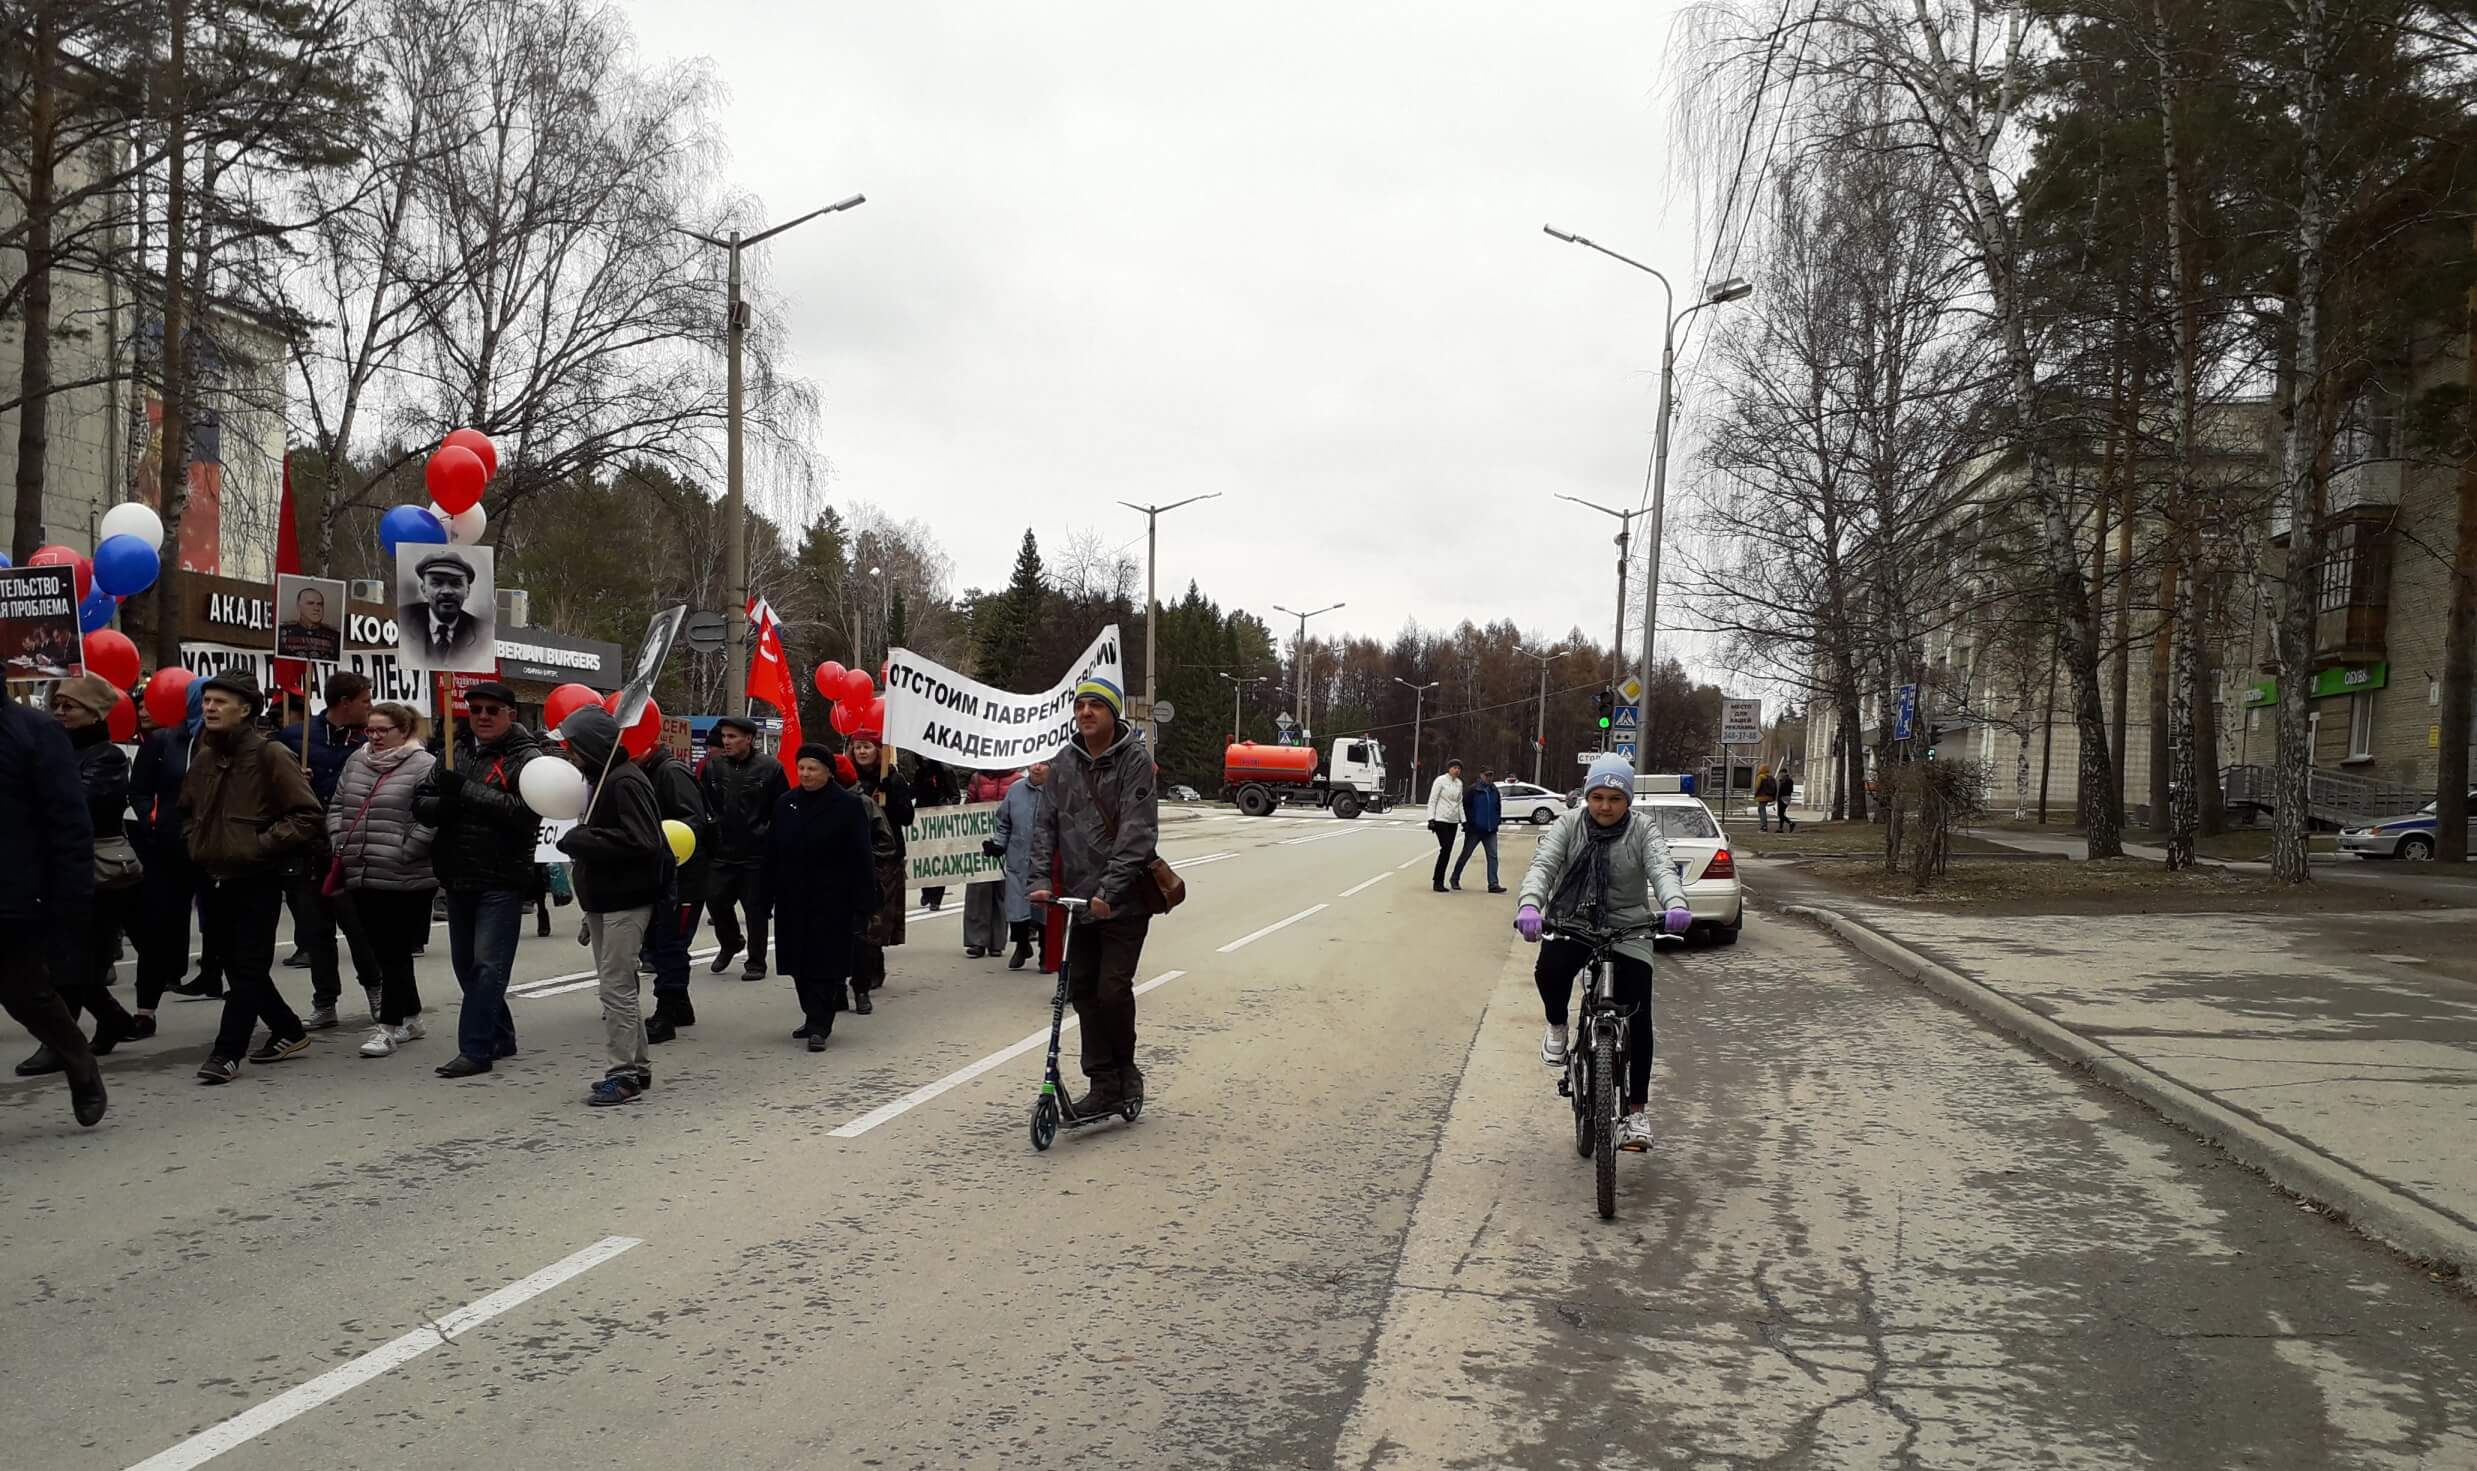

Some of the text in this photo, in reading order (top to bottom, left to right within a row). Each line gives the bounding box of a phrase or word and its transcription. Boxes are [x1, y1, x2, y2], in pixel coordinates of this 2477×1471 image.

[10, 598, 70, 617] ПРОБЛЕМА
[546, 647, 601, 671] BURGERS
[889, 664, 978, 716] ОТСТОИМ
